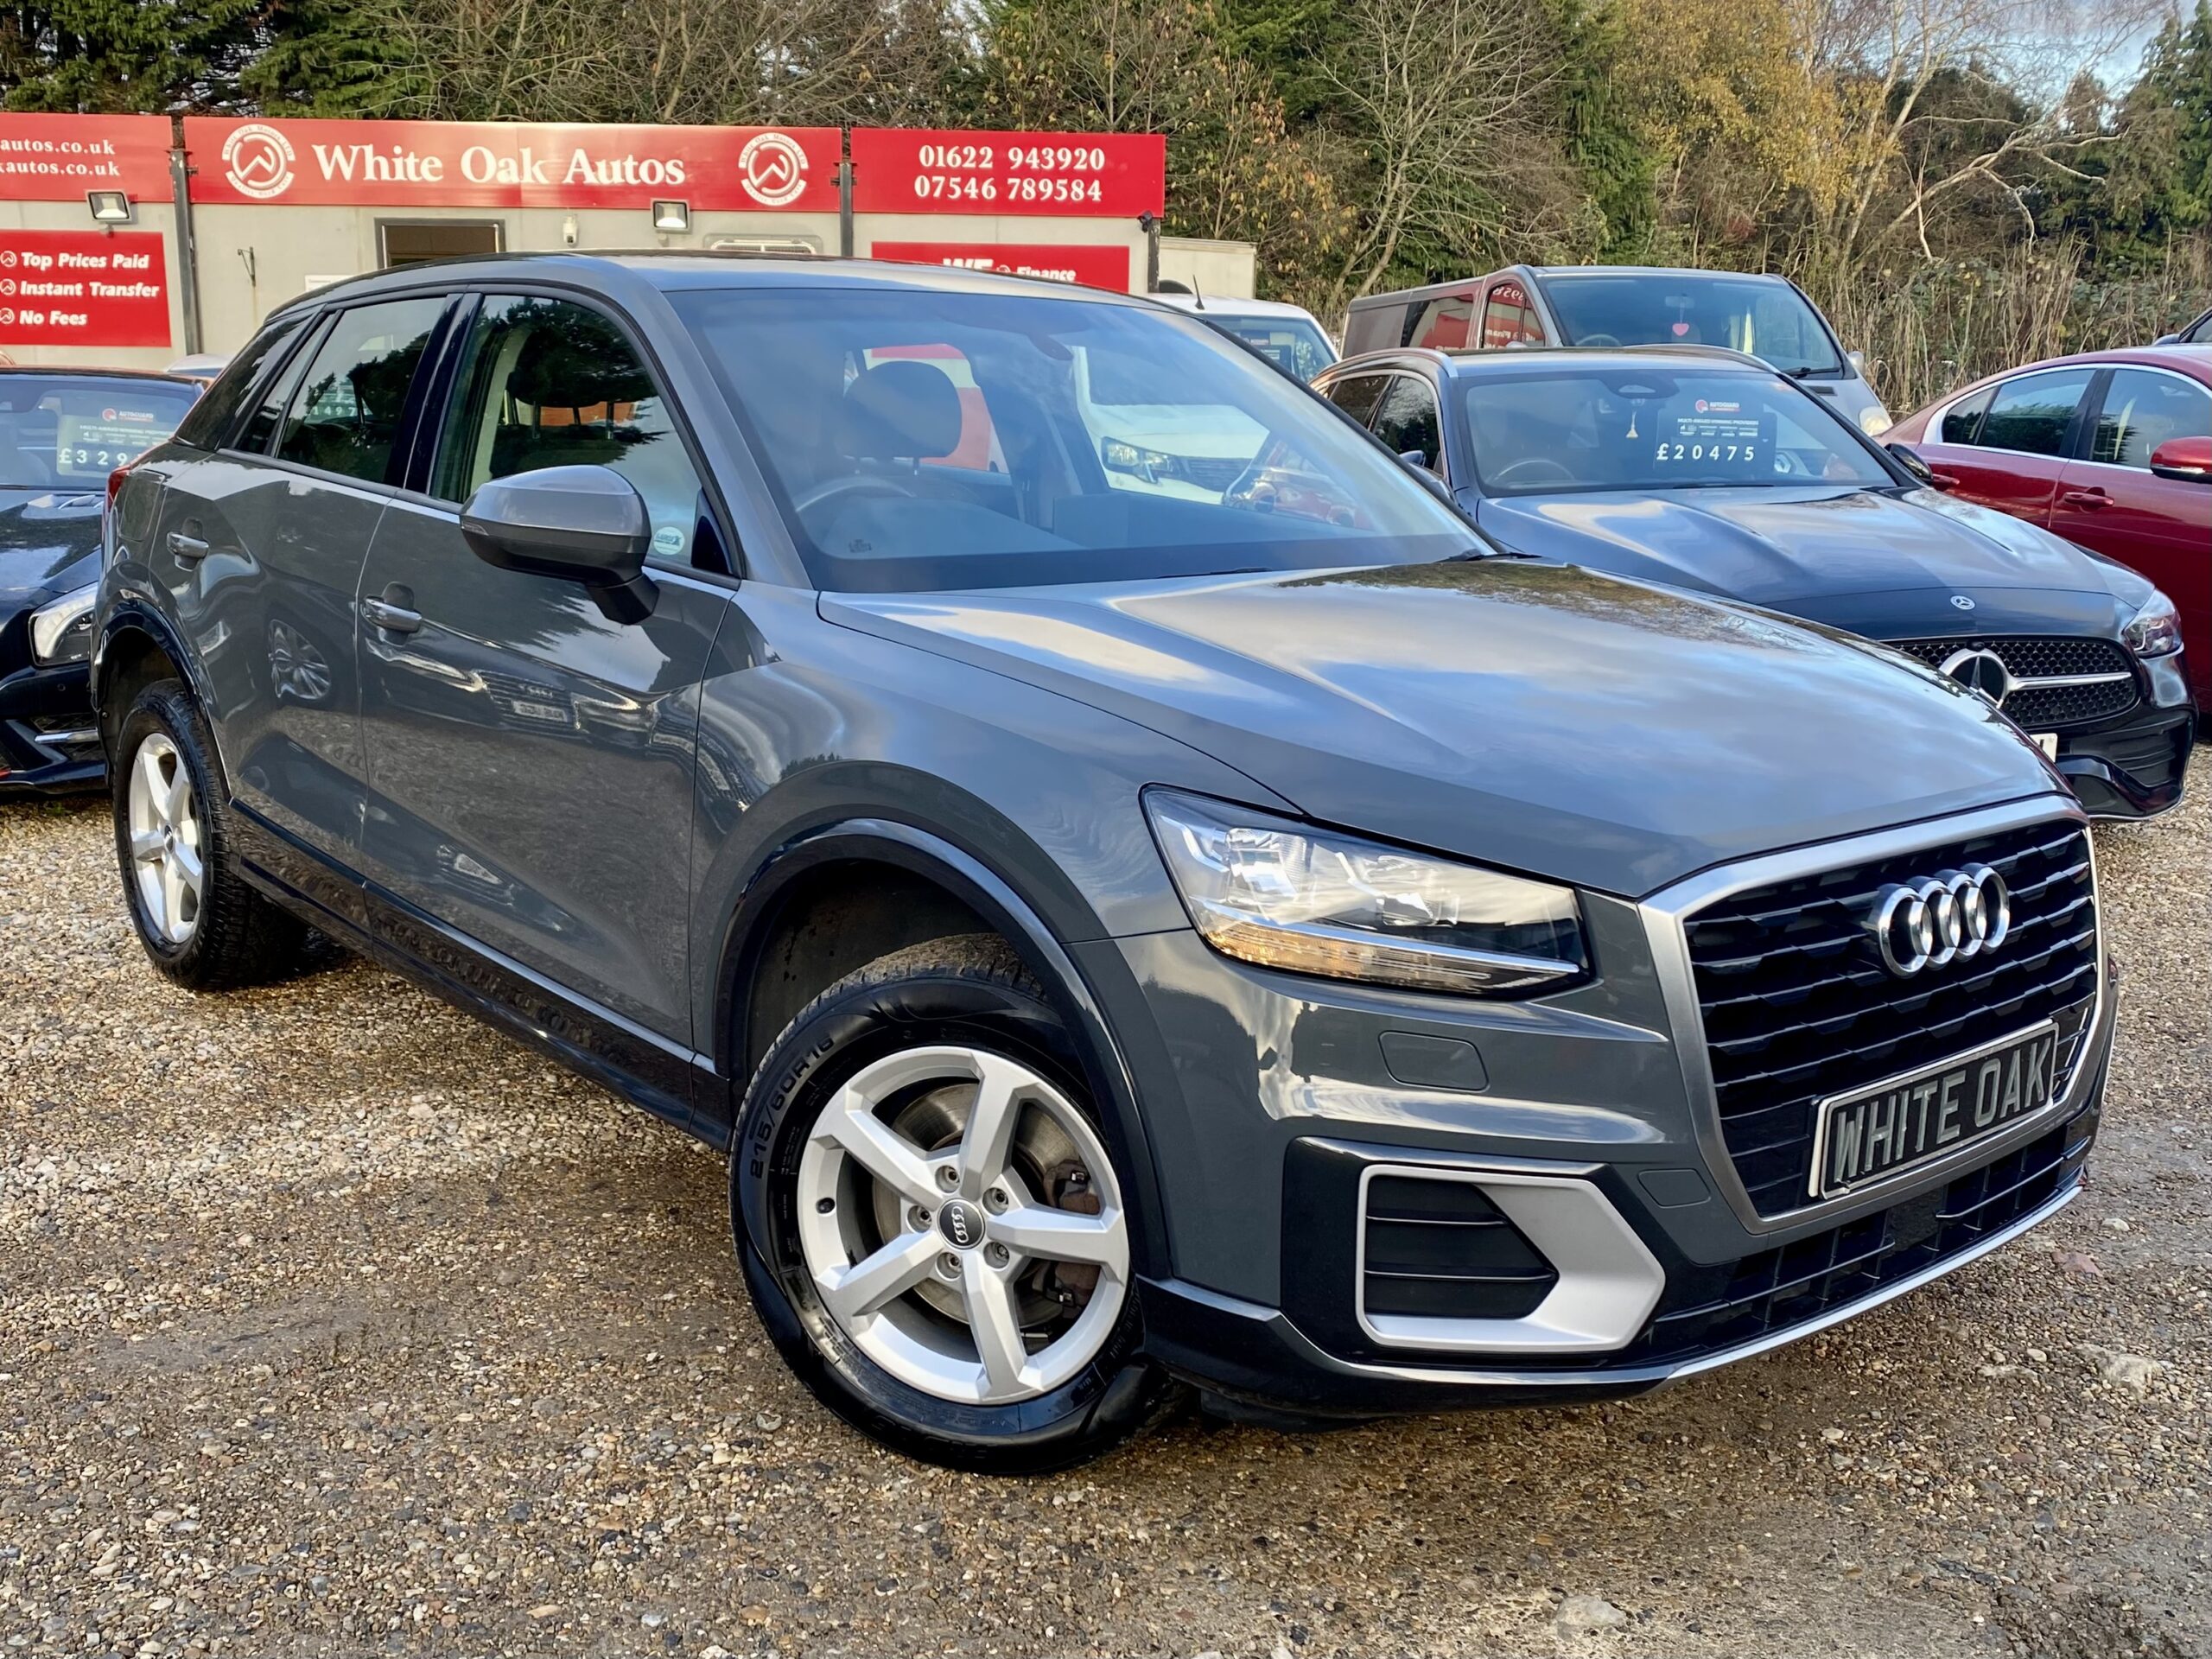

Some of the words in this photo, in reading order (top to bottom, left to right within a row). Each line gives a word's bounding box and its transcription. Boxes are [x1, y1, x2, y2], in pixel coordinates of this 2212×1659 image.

[311, 143, 443, 182] White
[461, 145, 547, 184] Oak
[564, 148, 686, 185] Autos
[919, 145, 993, 168] 01622
[1008, 148, 1104, 170] 943920
[915, 175, 996, 199] 07546
[1007, 178, 1102, 200] 789584
[22, 252, 52, 270] Top
[59, 253, 106, 268] Prices
[112, 254, 149, 268] Paid
[21, 281, 82, 296] Instant
[90, 283, 159, 296] Transfer
[20, 310, 44, 324] No
[50, 311, 86, 325] Fees
[59, 448, 142, 467] £329
[1656, 443, 1755, 461] £20475
[1834, 1070, 1967, 1182] WHITE
[1974, 1037, 2052, 1128] OAK
